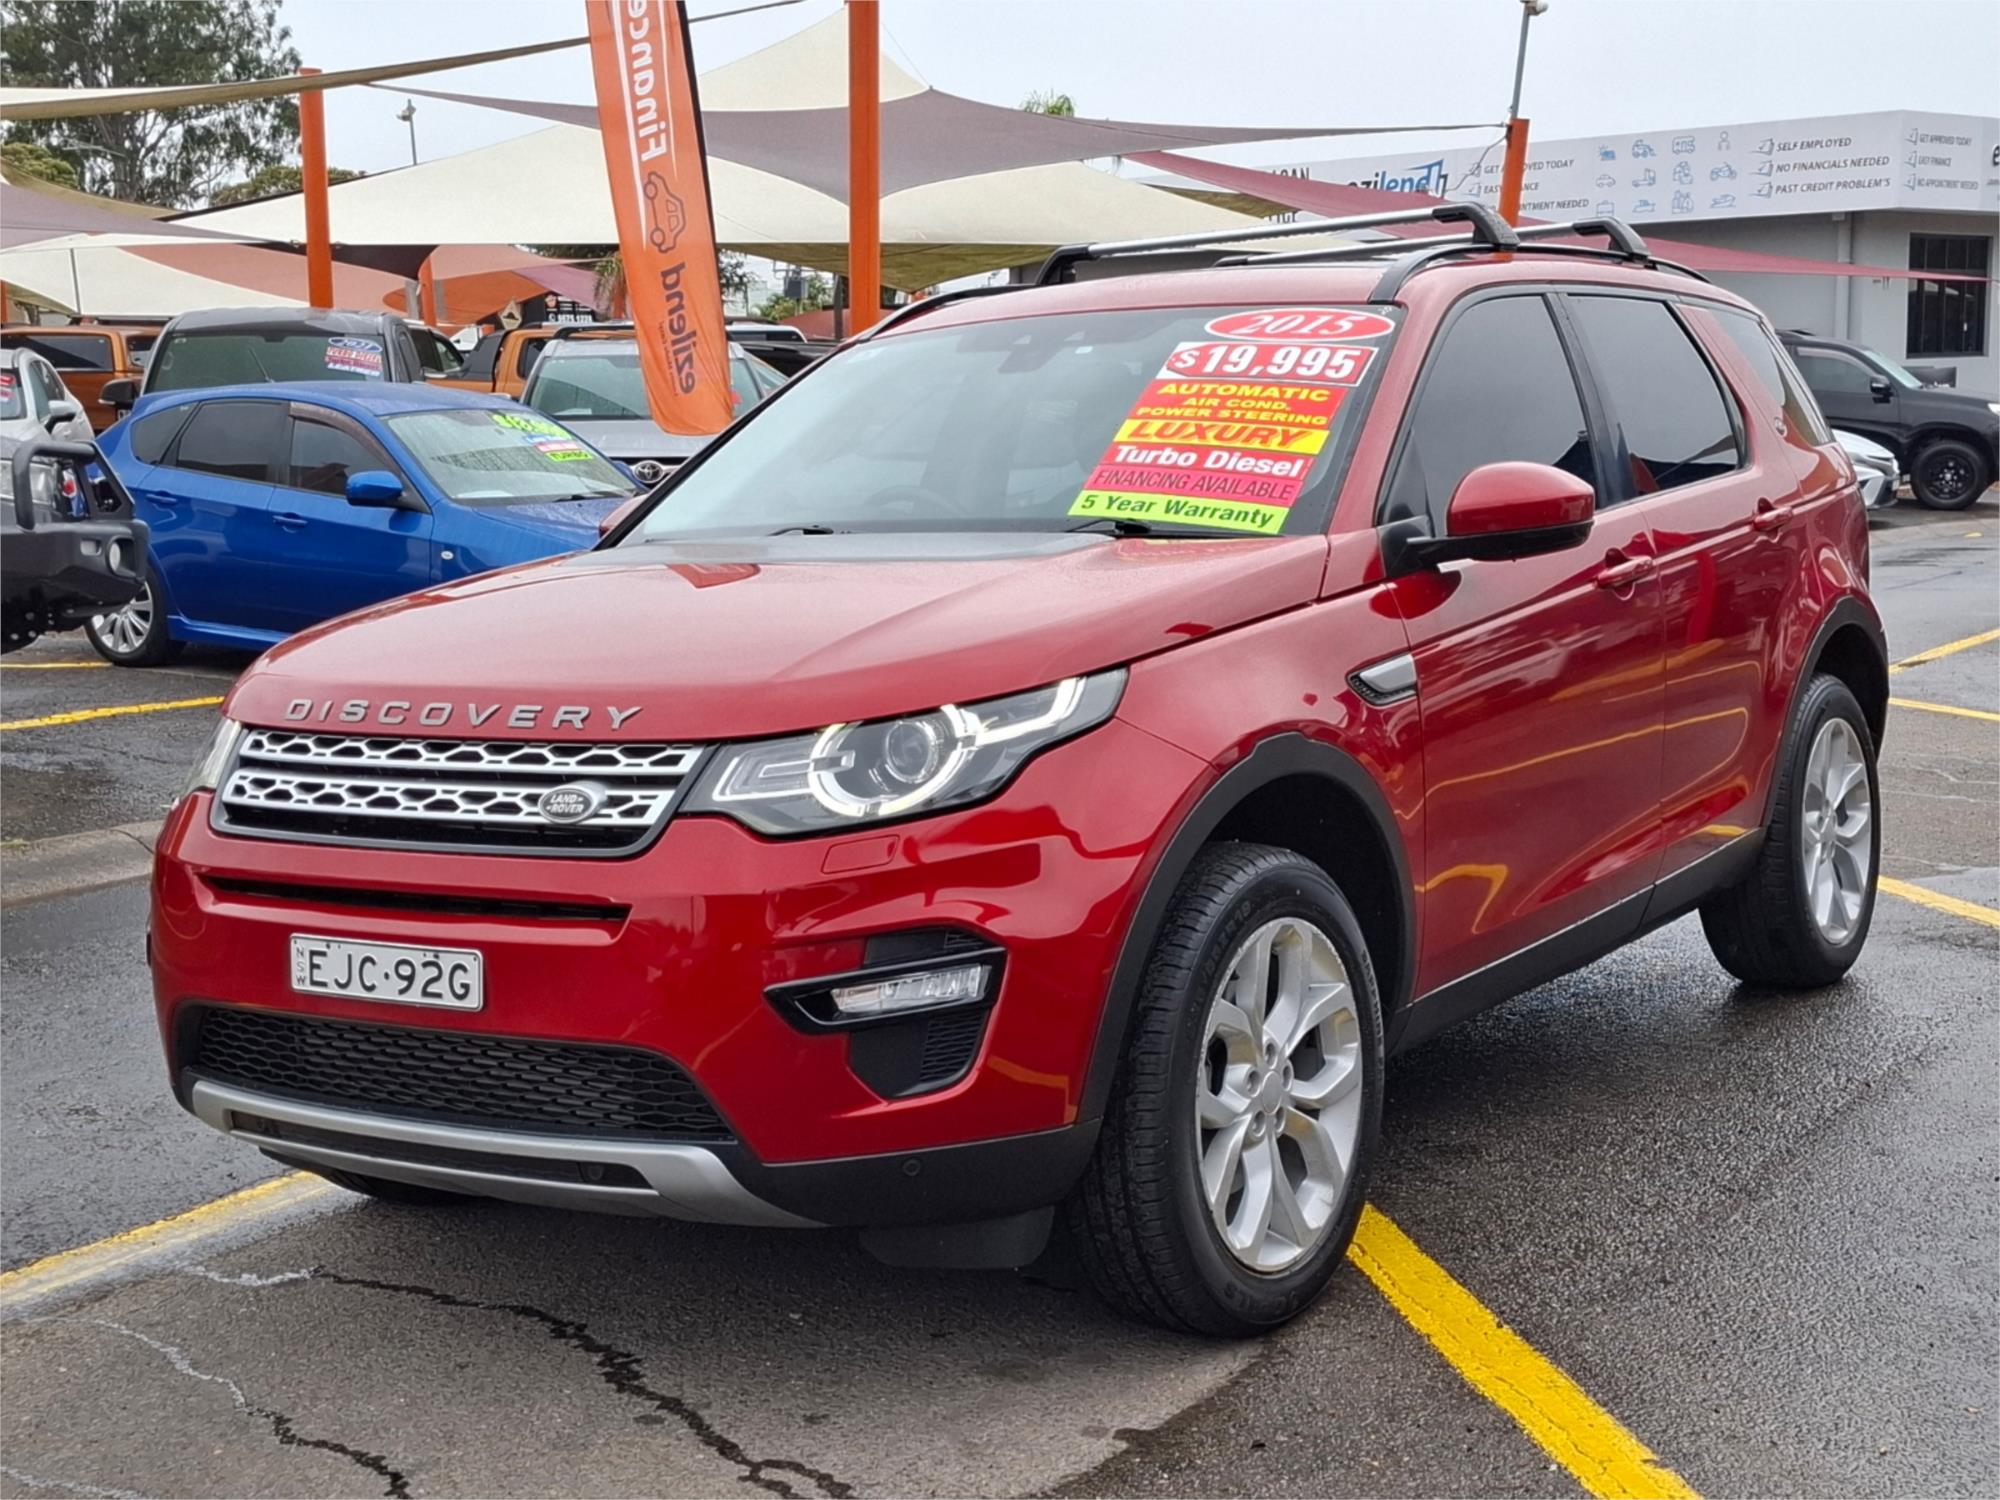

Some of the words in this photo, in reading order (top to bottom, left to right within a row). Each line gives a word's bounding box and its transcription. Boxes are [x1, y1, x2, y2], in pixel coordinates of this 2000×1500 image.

[1776, 141, 1799, 152] SELF
[1800, 137, 1852, 150] EMPLOYED
[1484, 165, 1499, 174] GET
[1546, 159, 1575, 169] TODAY
[1776, 163, 1791, 173] NO
[1792, 159, 1849, 172] FINANCIALS
[1850, 156, 1890, 167] NEEDED
[1775, 183, 1799, 194] PAST
[1800, 181, 1835, 193] CREDIT
[1836, 178, 1891, 190] PROBLEM'S
[1556, 199, 1589, 209] NEEDED
[1236, 314, 1365, 336] 2015
[1175, 345, 1362, 379] $19,995
[1157, 383, 1331, 402] AUTOMATIC
[1183, 397, 1223, 407] AIR
[1228, 398, 1291, 411] COND.
[1136, 407, 1211, 419] POWER
[1217, 409, 1328, 426] STEERING
[1127, 421, 1307, 449] LUXURY
[1116, 446, 1198, 468] Turbo
[1204, 450, 1305, 477] Diesel
[1093, 469, 1190, 490] FINANCING
[1193, 476, 1296, 501] AVAILABLE
[1081, 494, 1096, 509] 5
[1105, 495, 1157, 513] Year
[1164, 500, 1275, 527] Warranty
[284, 698, 642, 732] DISCOVERY
